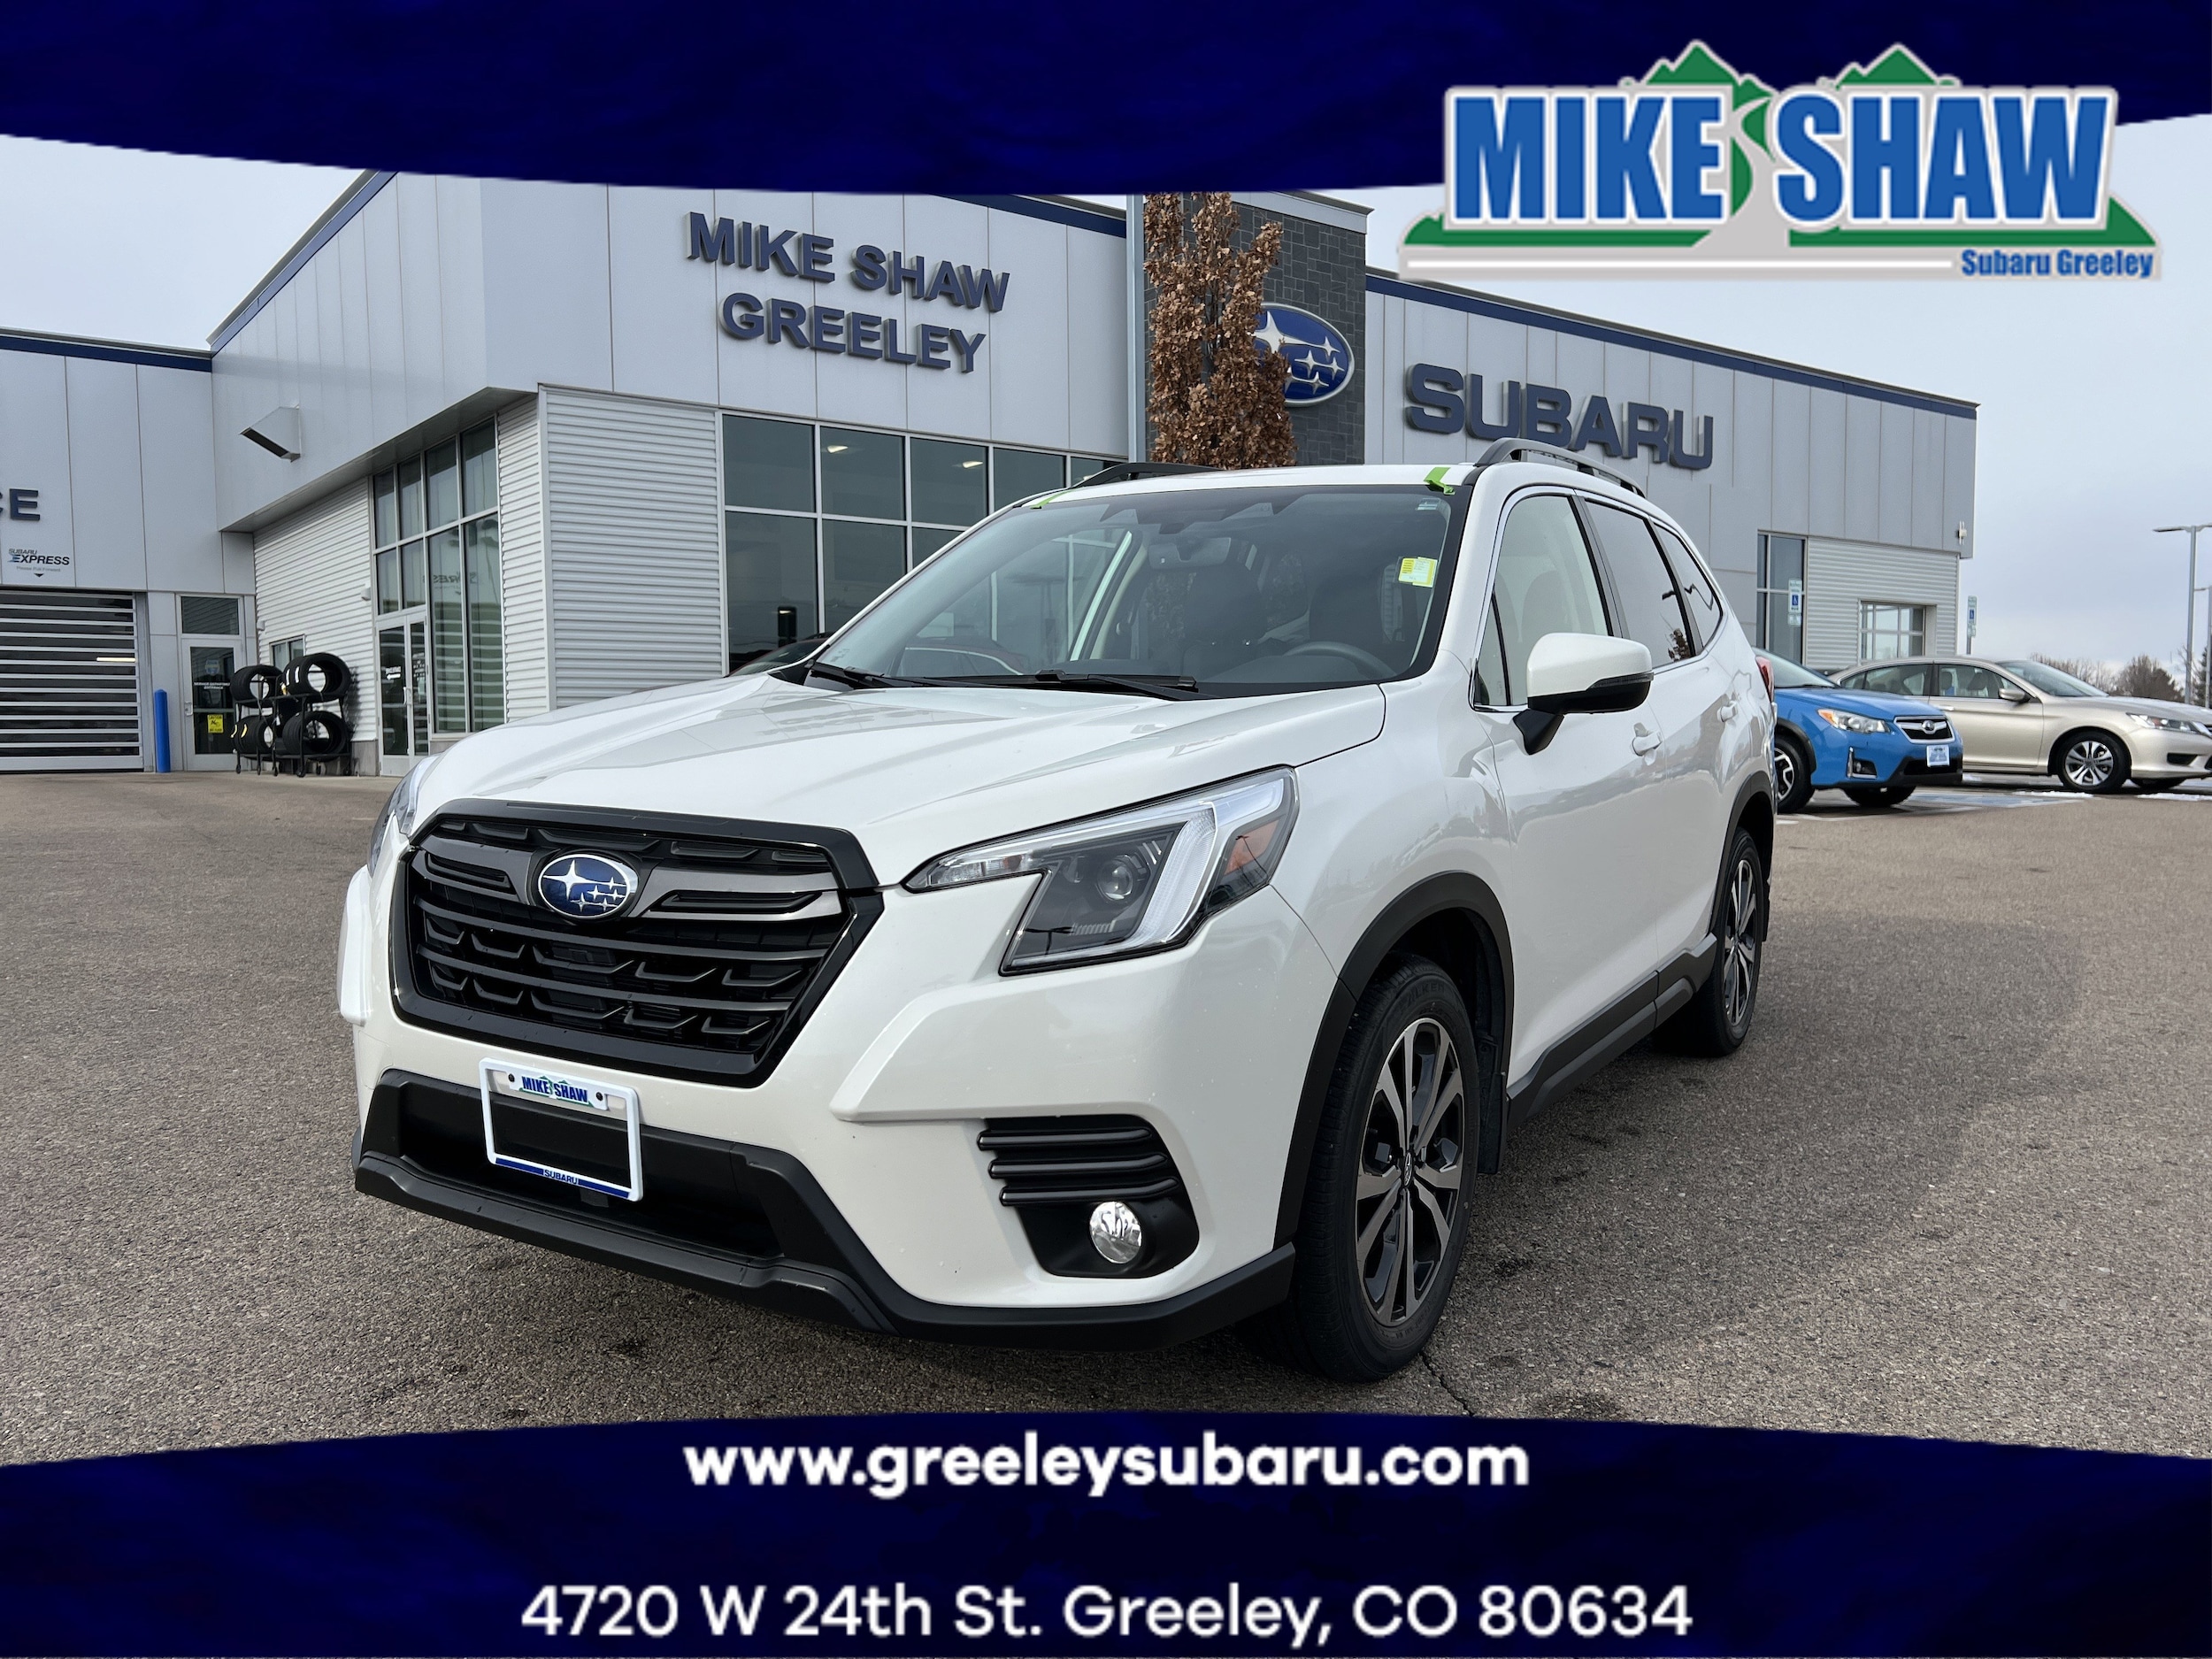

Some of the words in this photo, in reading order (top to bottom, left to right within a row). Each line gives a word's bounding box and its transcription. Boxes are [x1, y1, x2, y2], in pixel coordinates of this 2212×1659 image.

[686, 211, 835, 283] MIKE
[849, 244, 1010, 312] SHAW
[718, 292, 987, 373] GREELEY
[1404, 363, 1714, 471] SUBARU
[0, 488, 41, 521] E
[7, 554, 70, 565] EXPRESS
[521, 1076, 549, 1094] MIKE
[553, 1083, 588, 1102] SHAW
[544, 1169, 578, 1185] SUBARU
